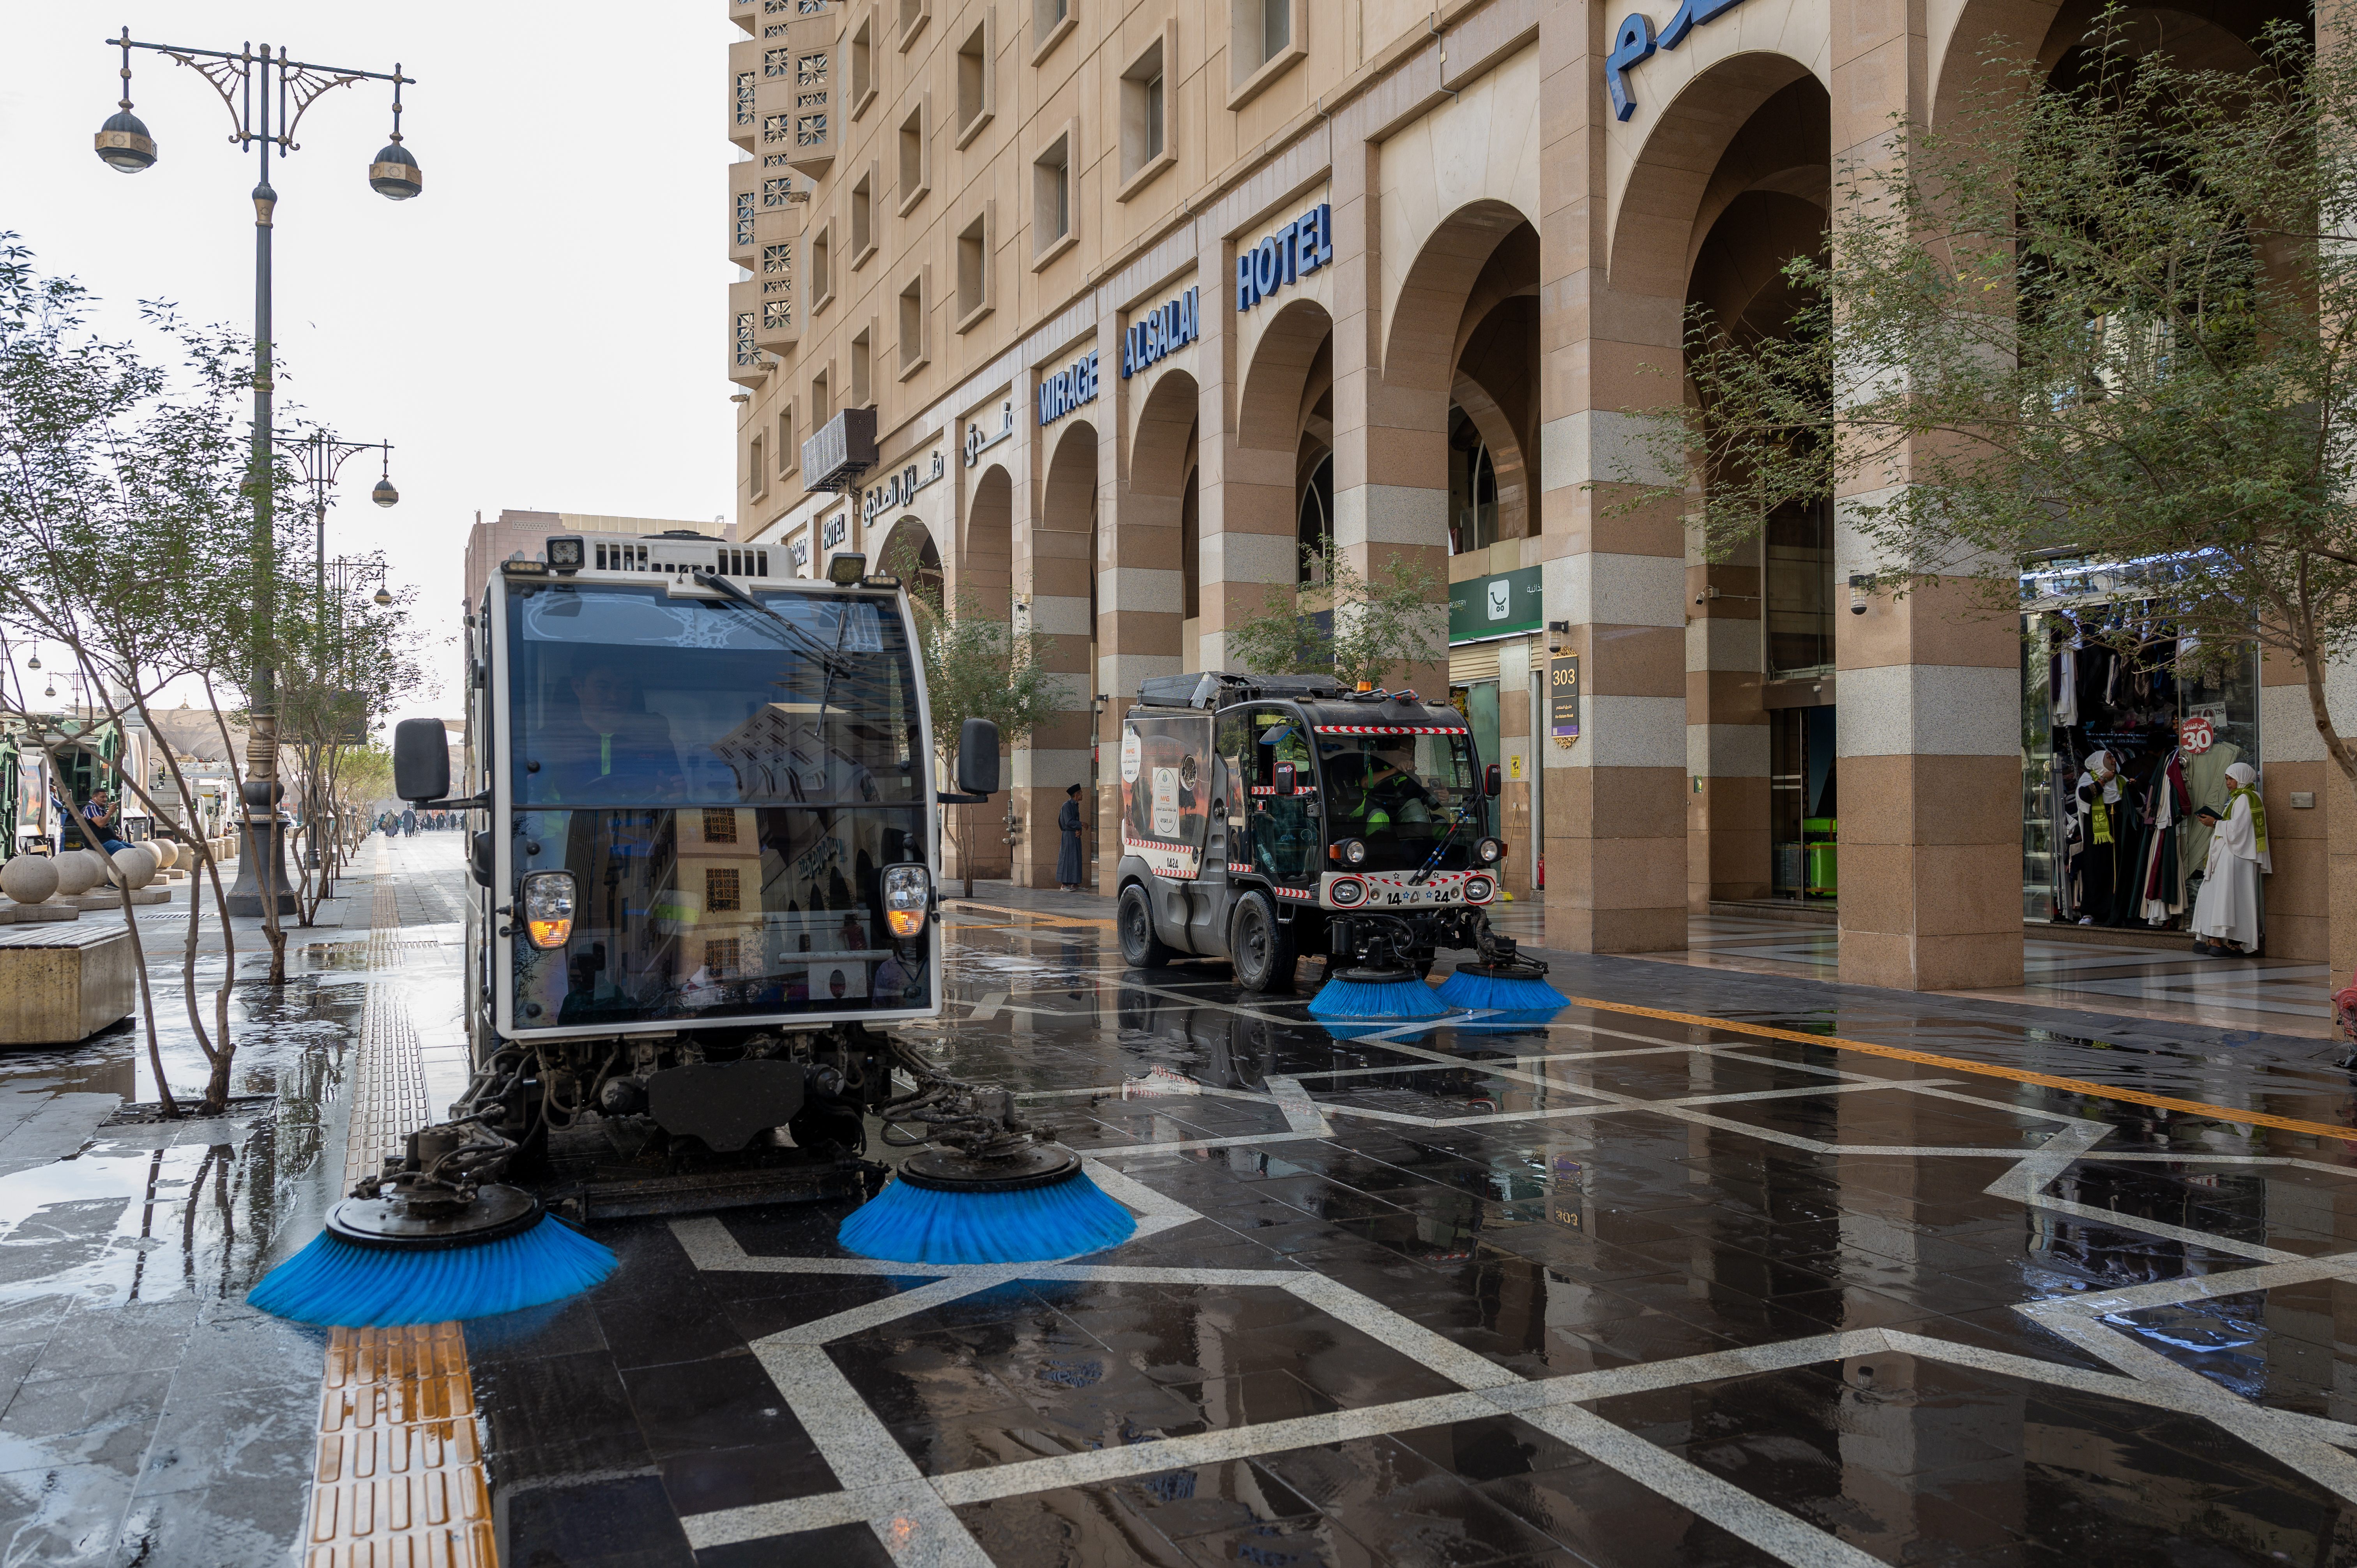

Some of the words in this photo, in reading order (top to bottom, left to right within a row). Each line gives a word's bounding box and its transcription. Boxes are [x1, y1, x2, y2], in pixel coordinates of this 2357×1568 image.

[1039, 349, 1098, 426] MIRAGE
[1237, 203, 1333, 312] HOTEL
[862, 475, 899, 528] الصادق
[824, 514, 845, 550] HOTEL
[1527, 584, 1542, 595] ذائية
[1449, 599, 1467, 609] ROCERY
[1553, 668, 1575, 686] 303
[2182, 729, 2211, 750] 30
[1167, 857, 1178, 869] 1424
[1387, 892, 1402, 905] 14
[1435, 890, 1451, 903] 24
